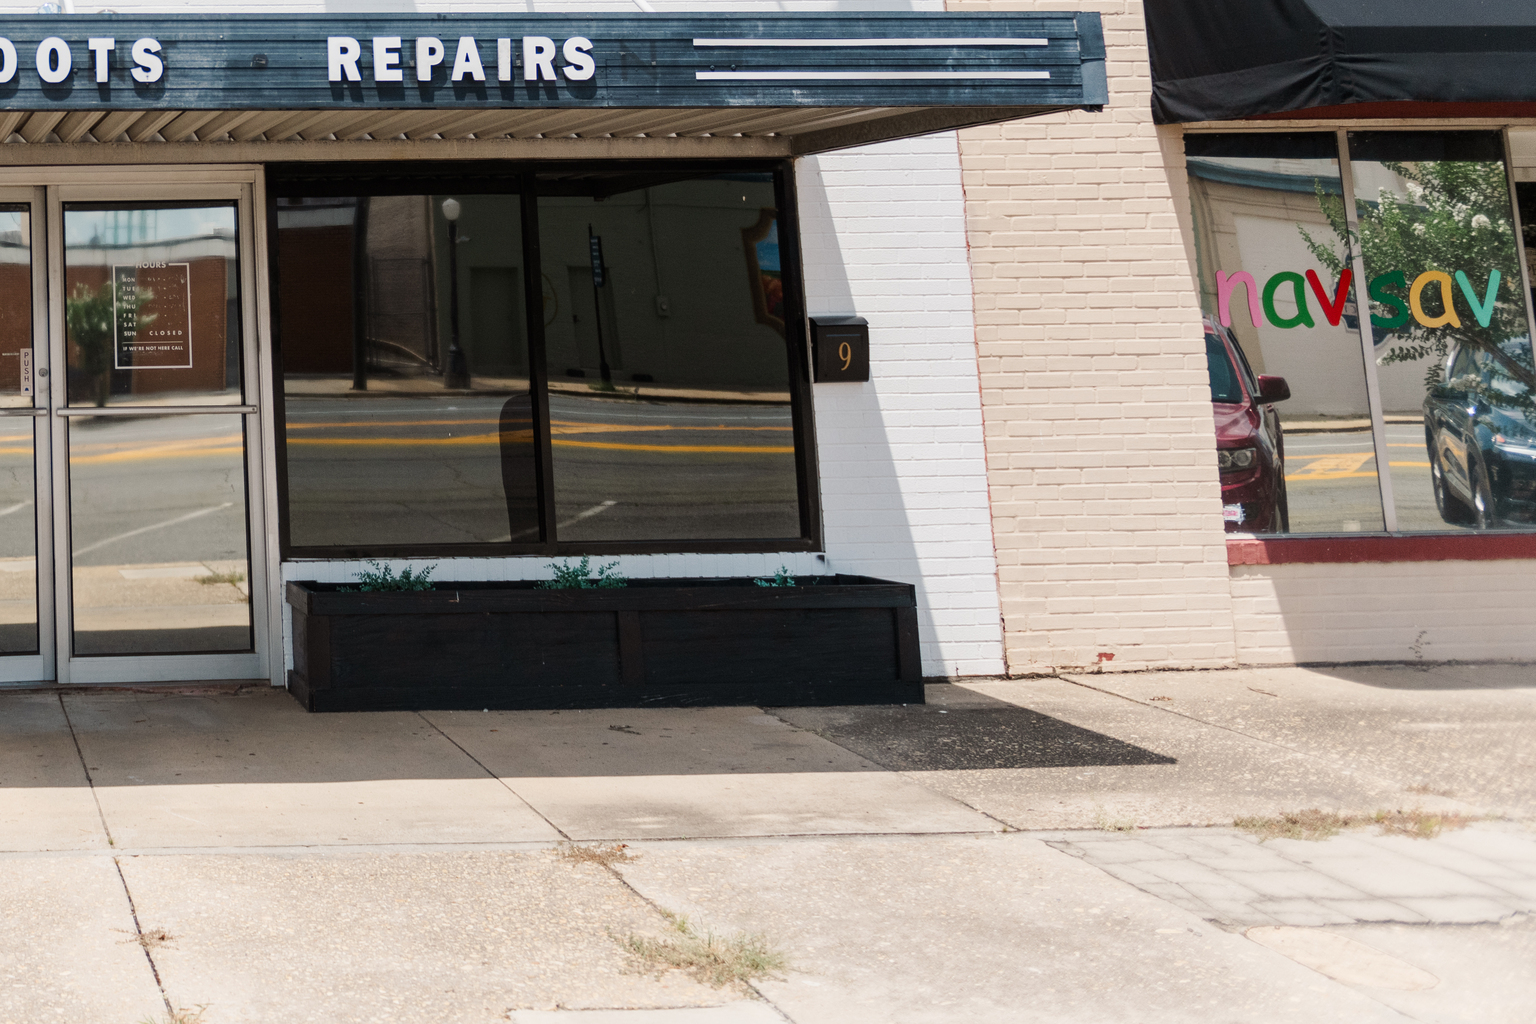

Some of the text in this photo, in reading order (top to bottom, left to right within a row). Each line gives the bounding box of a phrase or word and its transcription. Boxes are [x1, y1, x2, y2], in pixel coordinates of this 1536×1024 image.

[327, 35, 596, 82] REPAIRS
[135, 260, 166, 269] HOURS
[838, 341, 852, 371] 9
